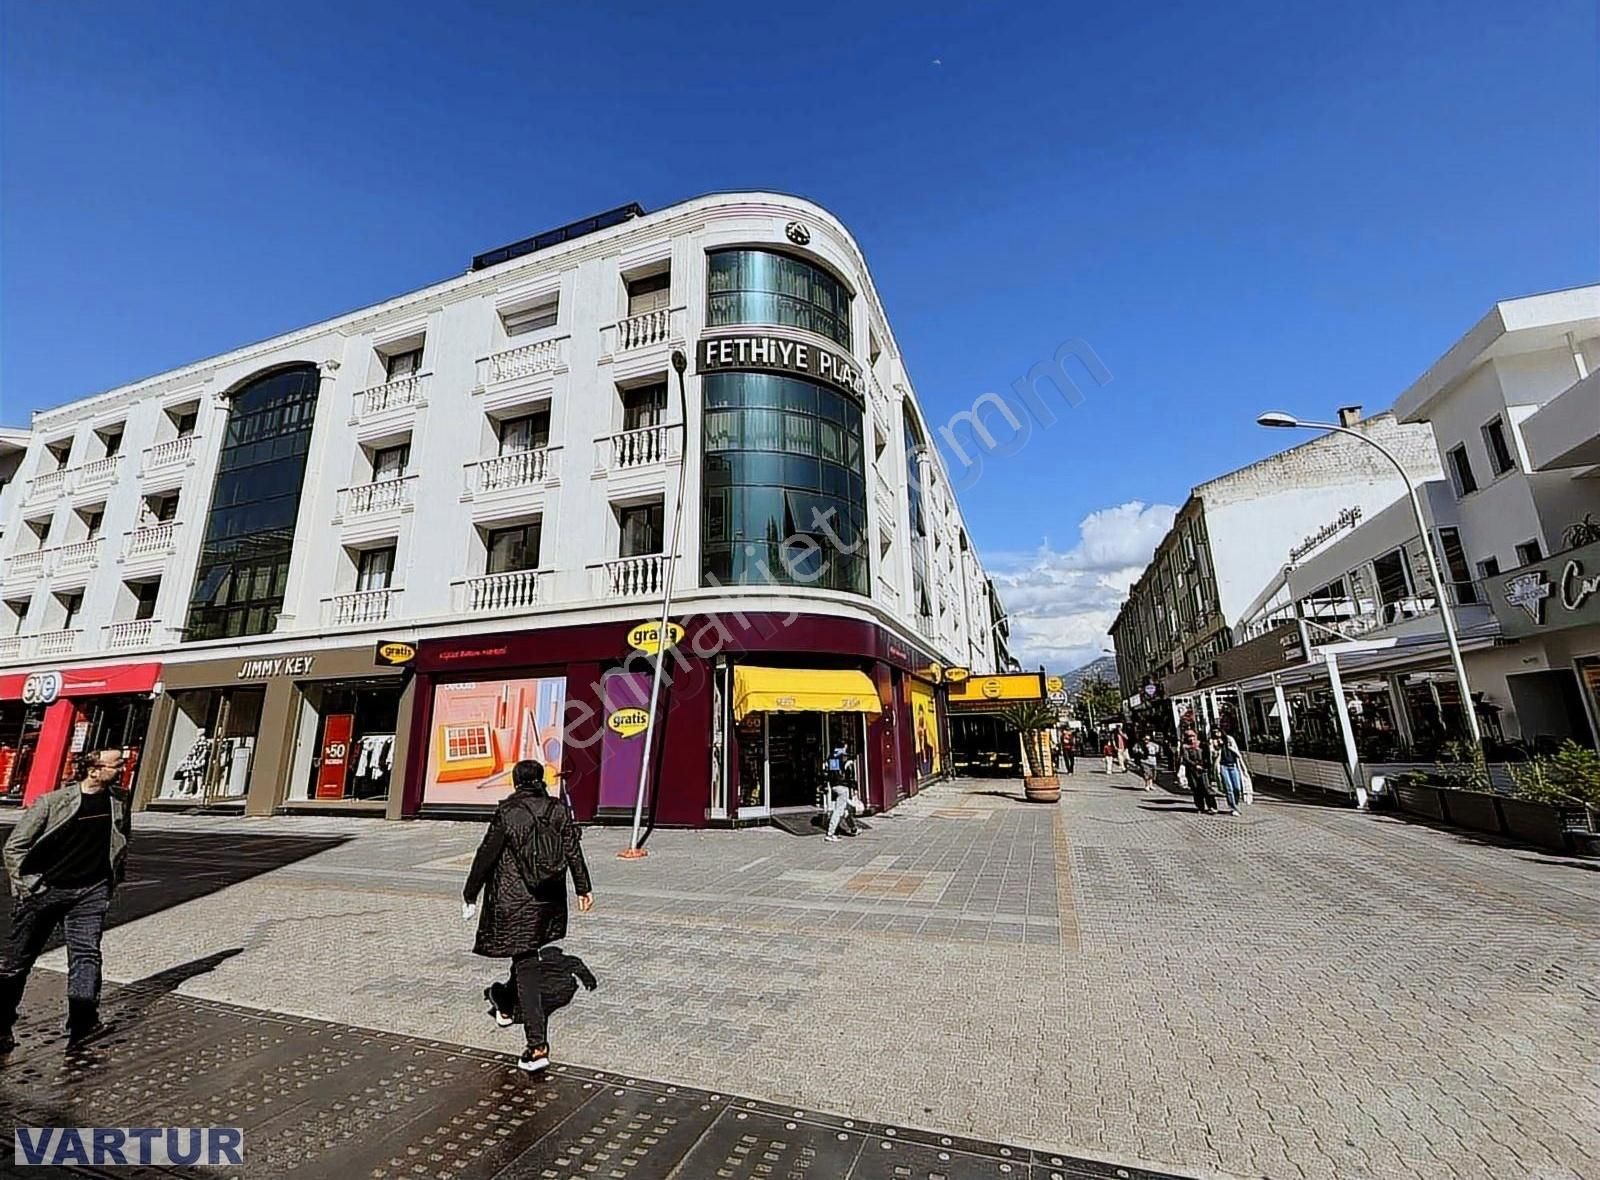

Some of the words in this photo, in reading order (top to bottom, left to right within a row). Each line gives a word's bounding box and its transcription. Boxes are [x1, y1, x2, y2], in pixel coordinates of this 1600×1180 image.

[633, 627, 678, 646] grais
[385, 646, 412, 657] gratis
[238, 660, 282, 678] JIMMY
[285, 656, 313, 675] KEY
[613, 712, 647, 728] gratis
